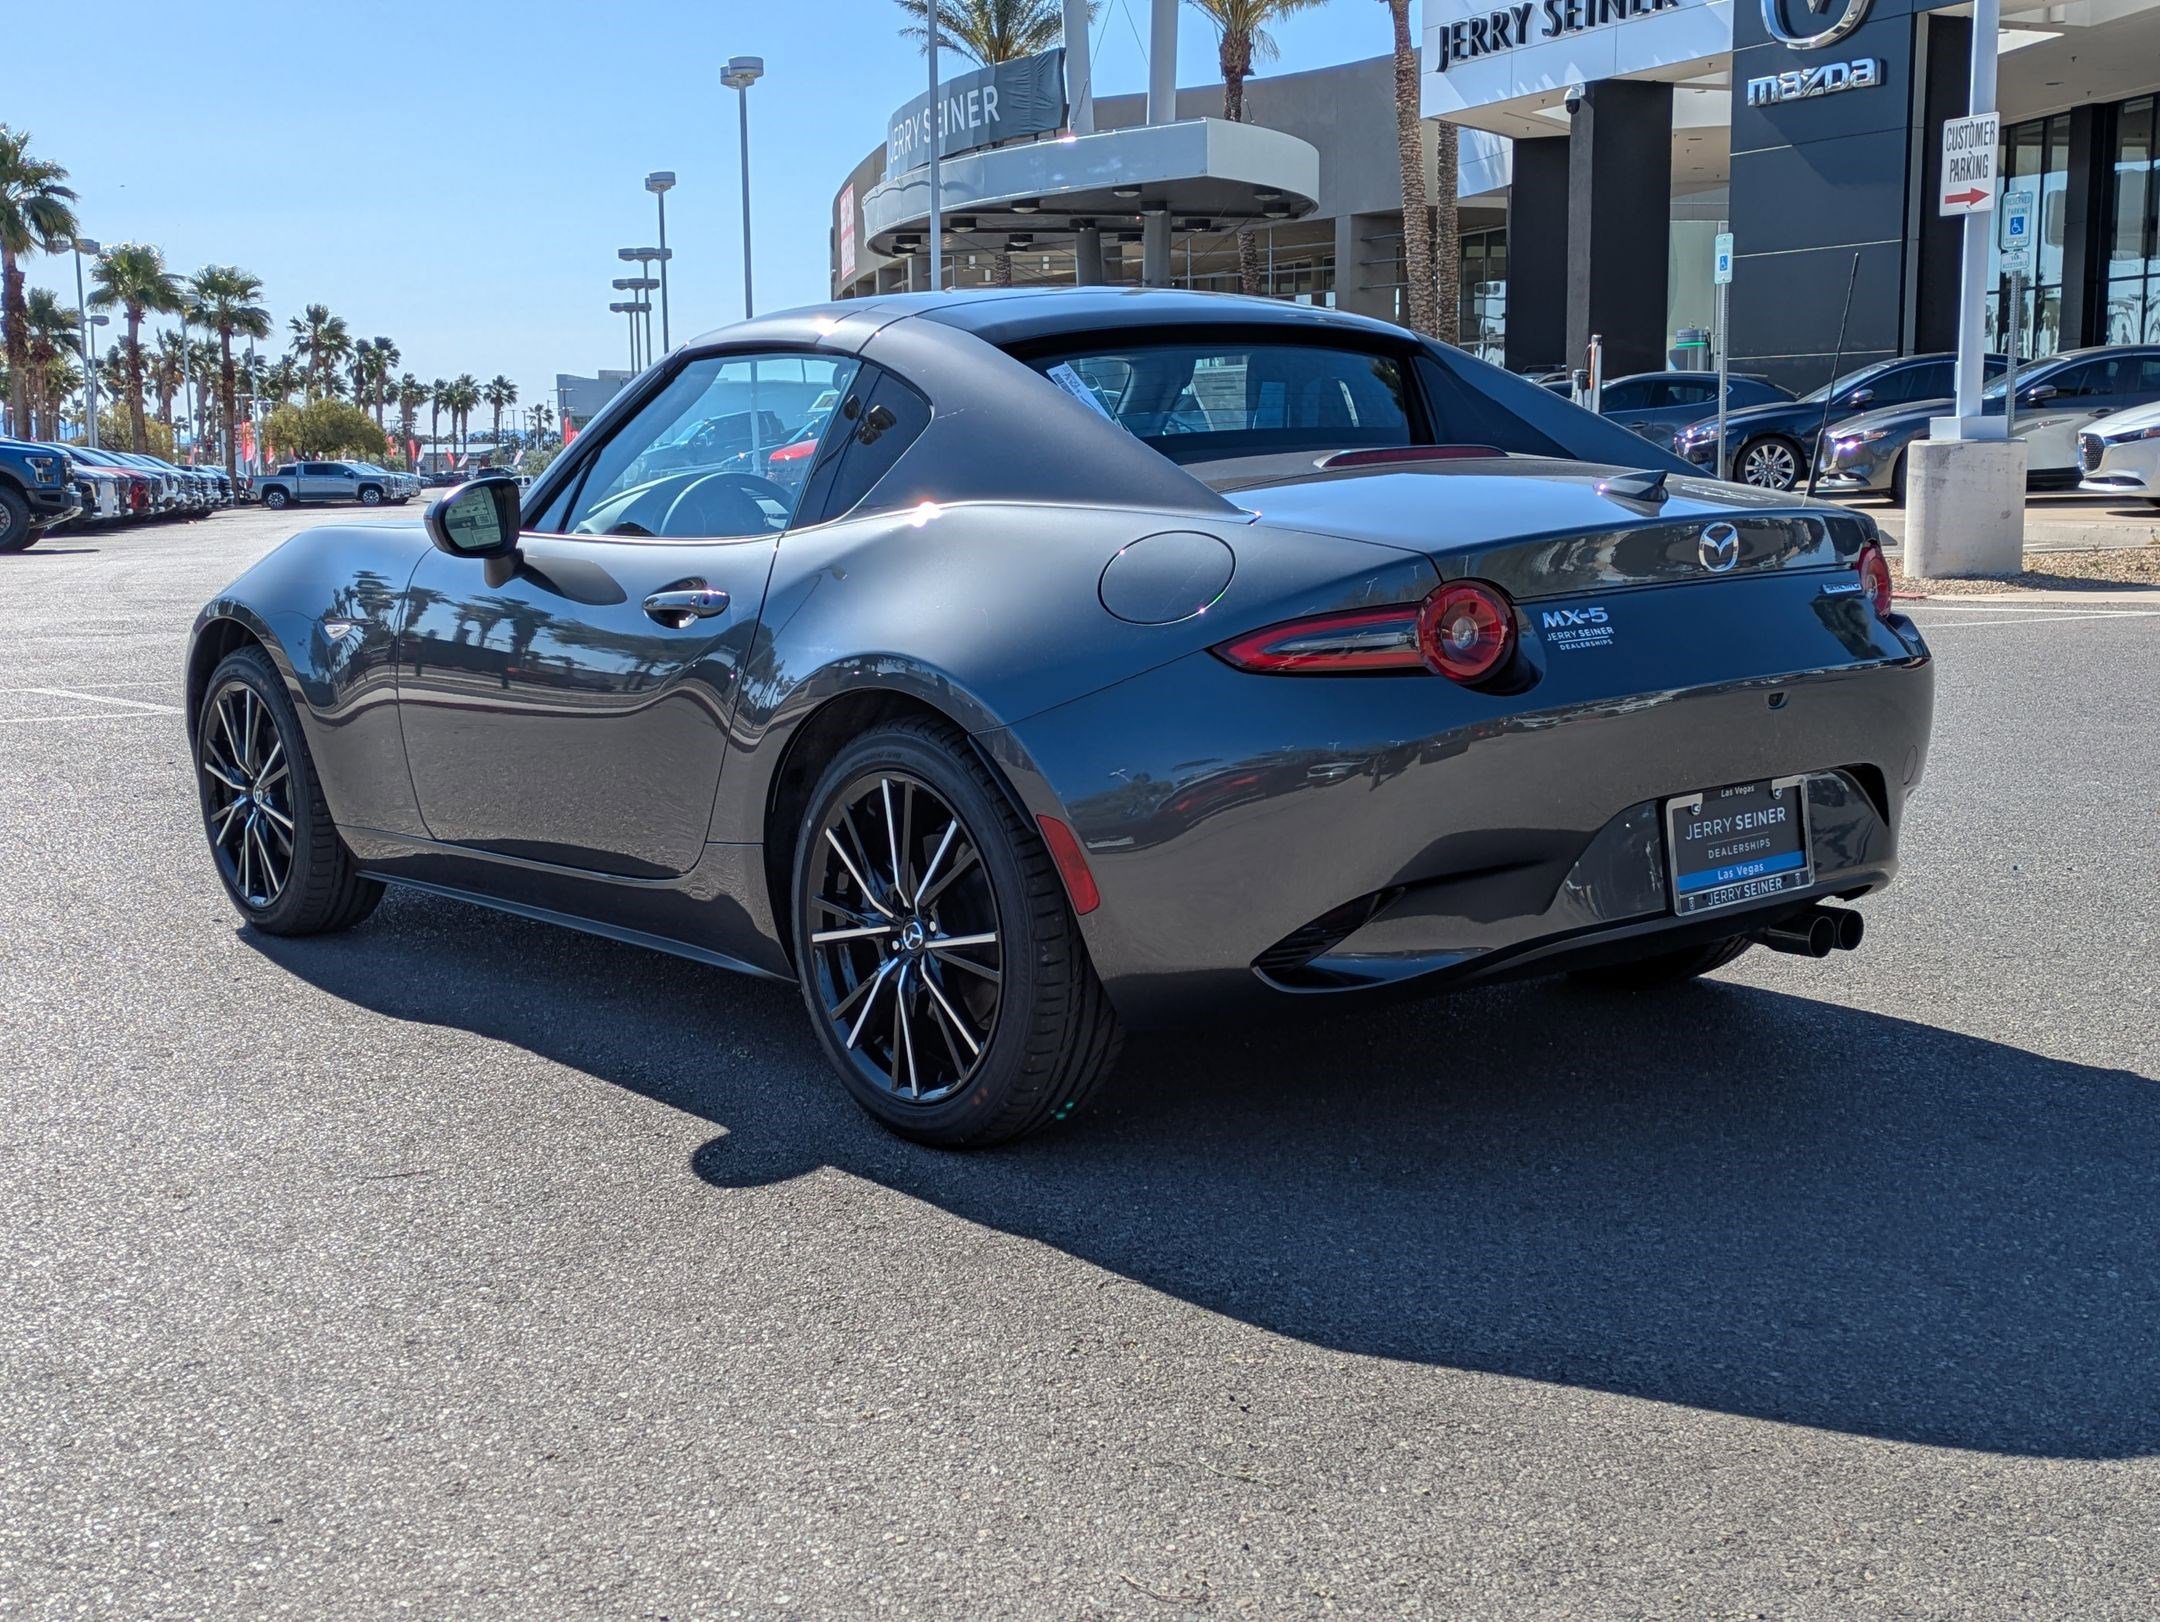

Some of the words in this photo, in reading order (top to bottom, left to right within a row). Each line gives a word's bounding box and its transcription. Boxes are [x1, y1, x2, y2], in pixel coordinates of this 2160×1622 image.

[1436, 2, 1533, 72] JERRY
[890, 112, 920, 164] JERRY
[1945, 120, 1996, 152] CUSTOMER
[1949, 153, 1989, 183] PARKING
[1542, 607, 1608, 628] MX-5
[1547, 630, 1576, 641] JERRY
[1578, 626, 1614, 637] SEINER
[1560, 639, 1613, 651] DEALERSHIPS
[1721, 789, 1733, 798] Las
[1734, 784, 1755, 797] Vegas
[1685, 817, 1732, 840] JERRY
[1735, 807, 1786, 830] SEINER
[1708, 838, 1771, 859] DEALERSHIPS
[1718, 871, 1734, 881] Las
[1736, 863, 1764, 877] Vegas
[1708, 886, 1743, 906] JERRY
[1744, 878, 1783, 897] SEINER
